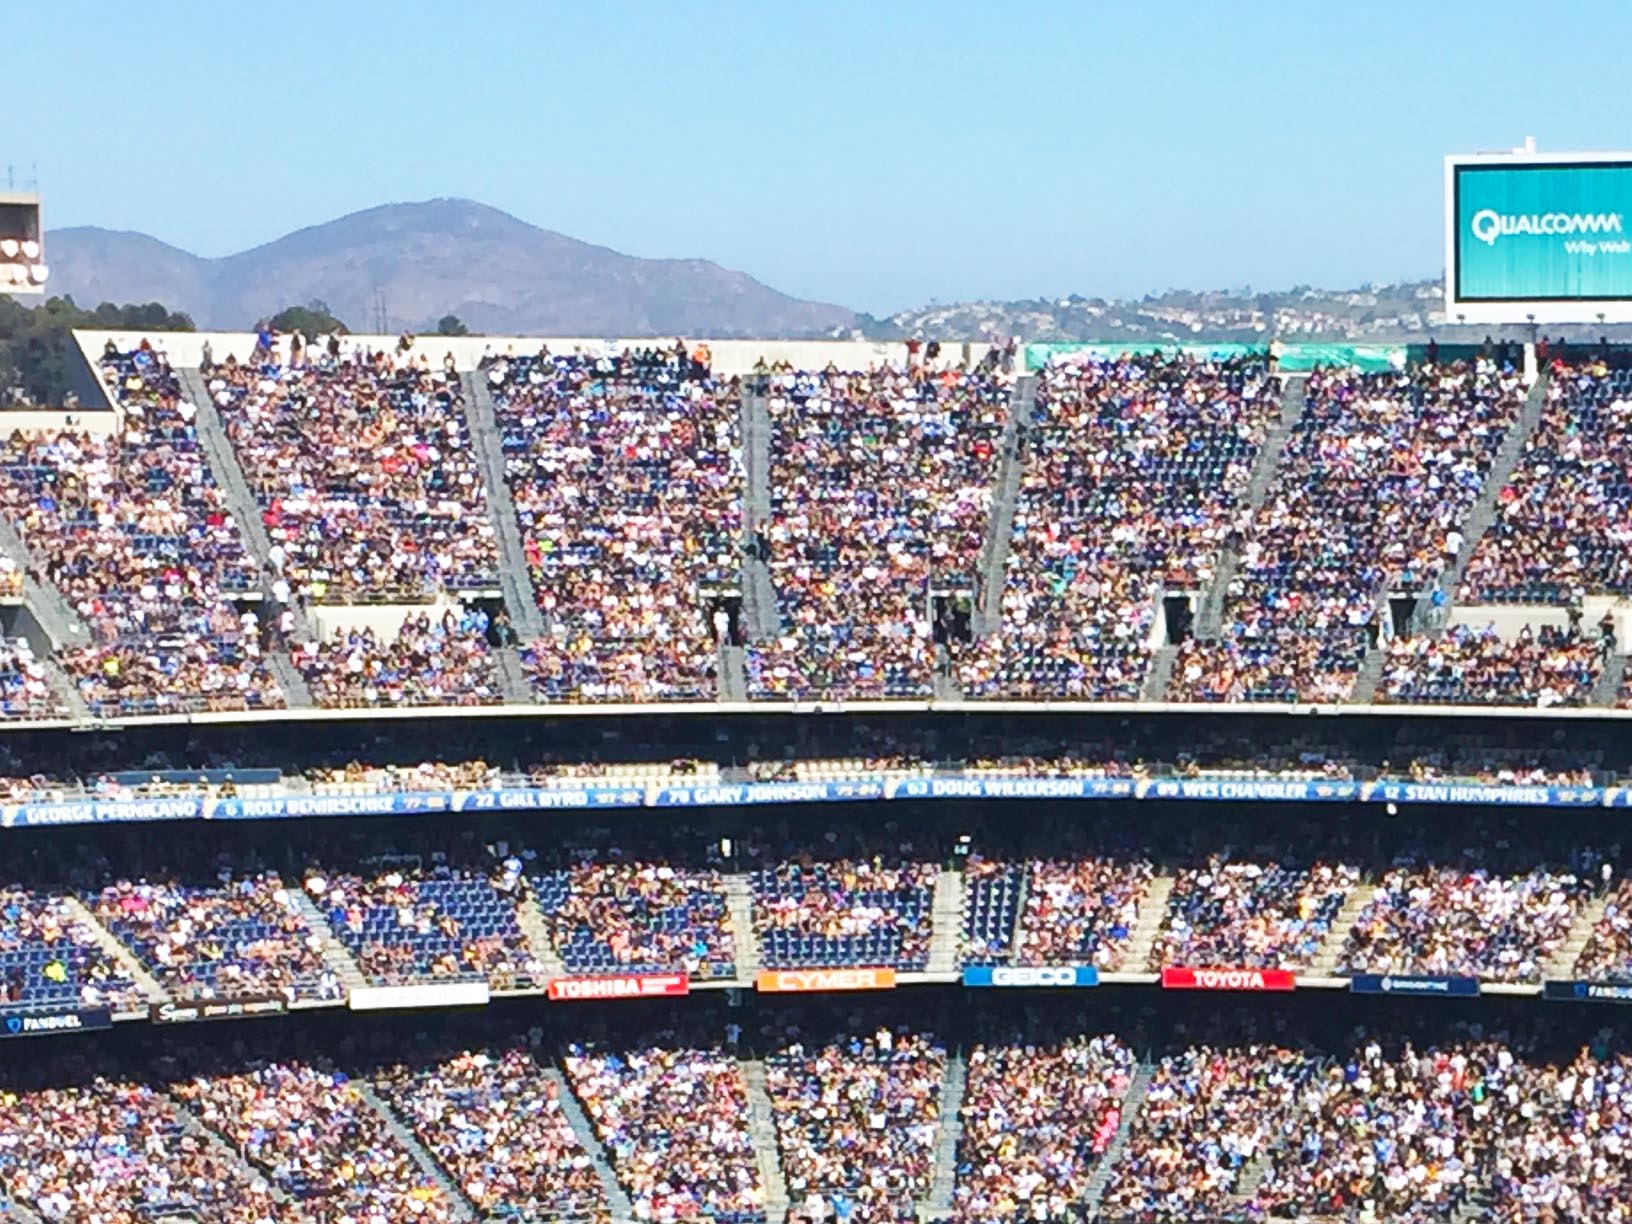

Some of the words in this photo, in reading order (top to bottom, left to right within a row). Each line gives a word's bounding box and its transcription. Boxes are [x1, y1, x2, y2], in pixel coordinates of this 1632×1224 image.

[1471, 209, 1624, 246] QUALCOMM
[1565, 239, 1597, 256] Why
[694, 787, 743, 803] GARY
[745, 784, 828, 802] JOHNSON
[932, 779, 981, 796] DOUG
[985, 779, 1084, 796] WILKERSON
[1183, 782, 1218, 798] WES
[1221, 782, 1307, 798] CHANDLER
[1404, 785, 1448, 801] STAN
[1450, 785, 1550, 803] HUMPHRIES
[242, 798, 284, 815] ROLF
[499, 791, 539, 808] GILL
[539, 790, 588, 807] BYRD
[25, 803, 94, 823] GEORGE
[96, 800, 196, 819] PERNICANO
[776, 970, 878, 989] CYMER
[991, 967, 1077, 986] GEICO
[1192, 970, 1265, 988] TOYOTA
[554, 976, 641, 998] TOSHIBA
[23, 1015, 82, 1031] FANDUEL
